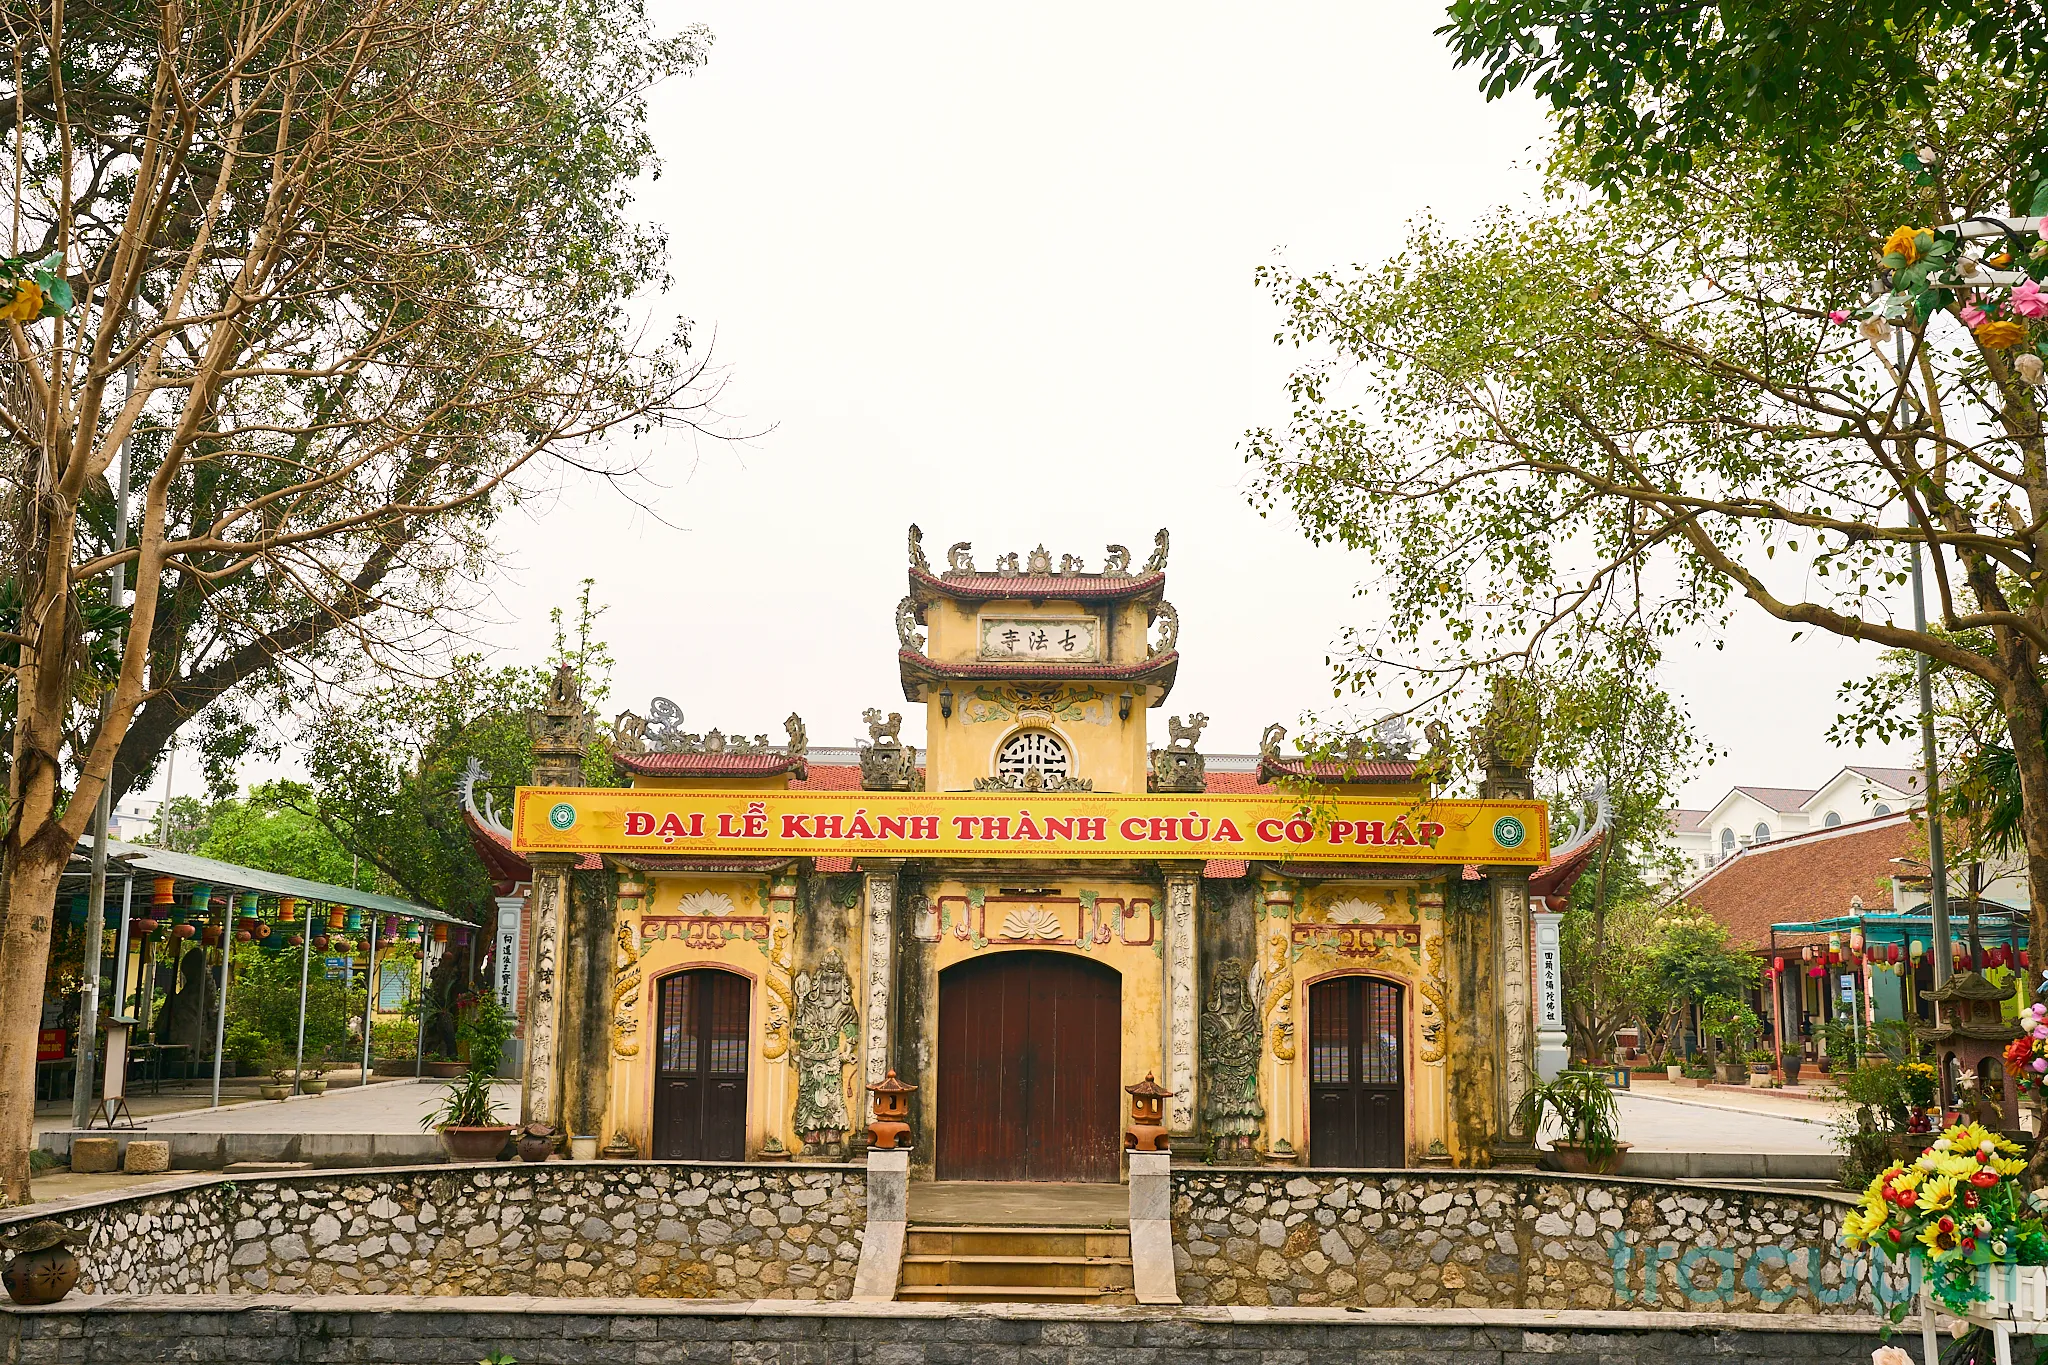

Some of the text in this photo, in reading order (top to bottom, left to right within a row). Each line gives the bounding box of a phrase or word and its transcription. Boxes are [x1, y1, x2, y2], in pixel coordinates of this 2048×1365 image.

[625, 812, 704, 844] ĐẠI
[716, 802, 768, 838] LỄ
[780, 808, 940, 840] KHÁNH
[952, 810, 1107, 841] THÀNH
[1119, 810, 1245, 842] CHÙA
[1328, 815, 1445, 847] PHÁP
